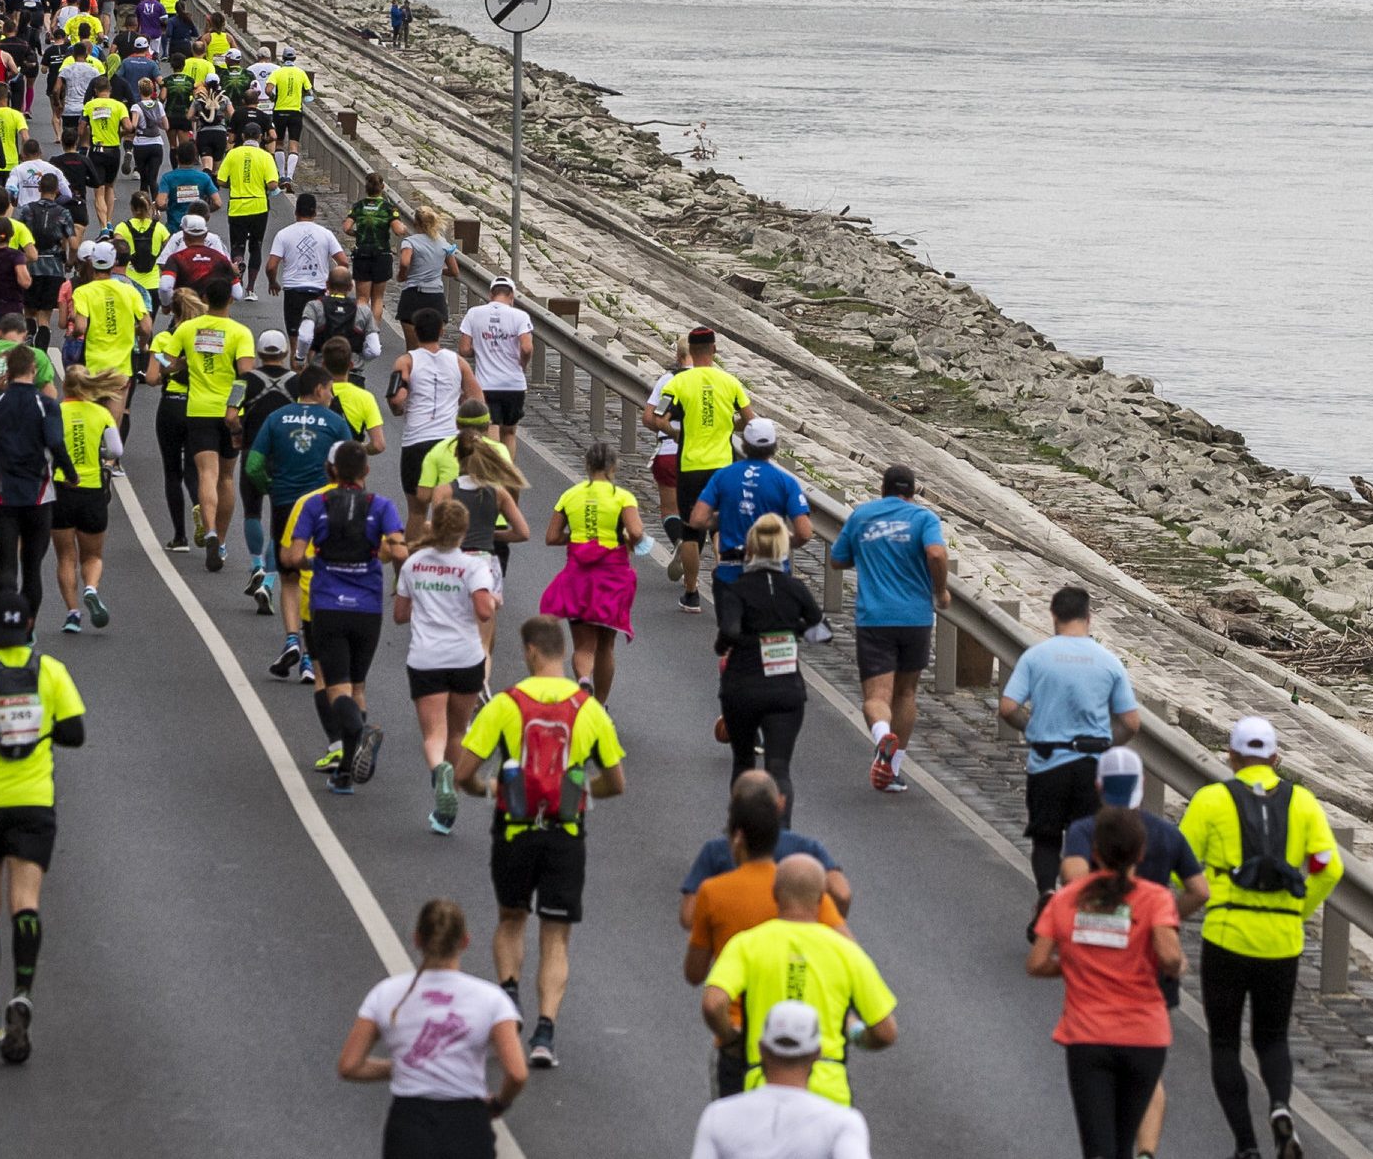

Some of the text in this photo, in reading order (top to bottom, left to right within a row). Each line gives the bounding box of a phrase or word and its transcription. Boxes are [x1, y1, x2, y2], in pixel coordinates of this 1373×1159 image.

[282, 415, 327, 426] SZABÓ B.
[412, 562, 466, 578] Hungary
